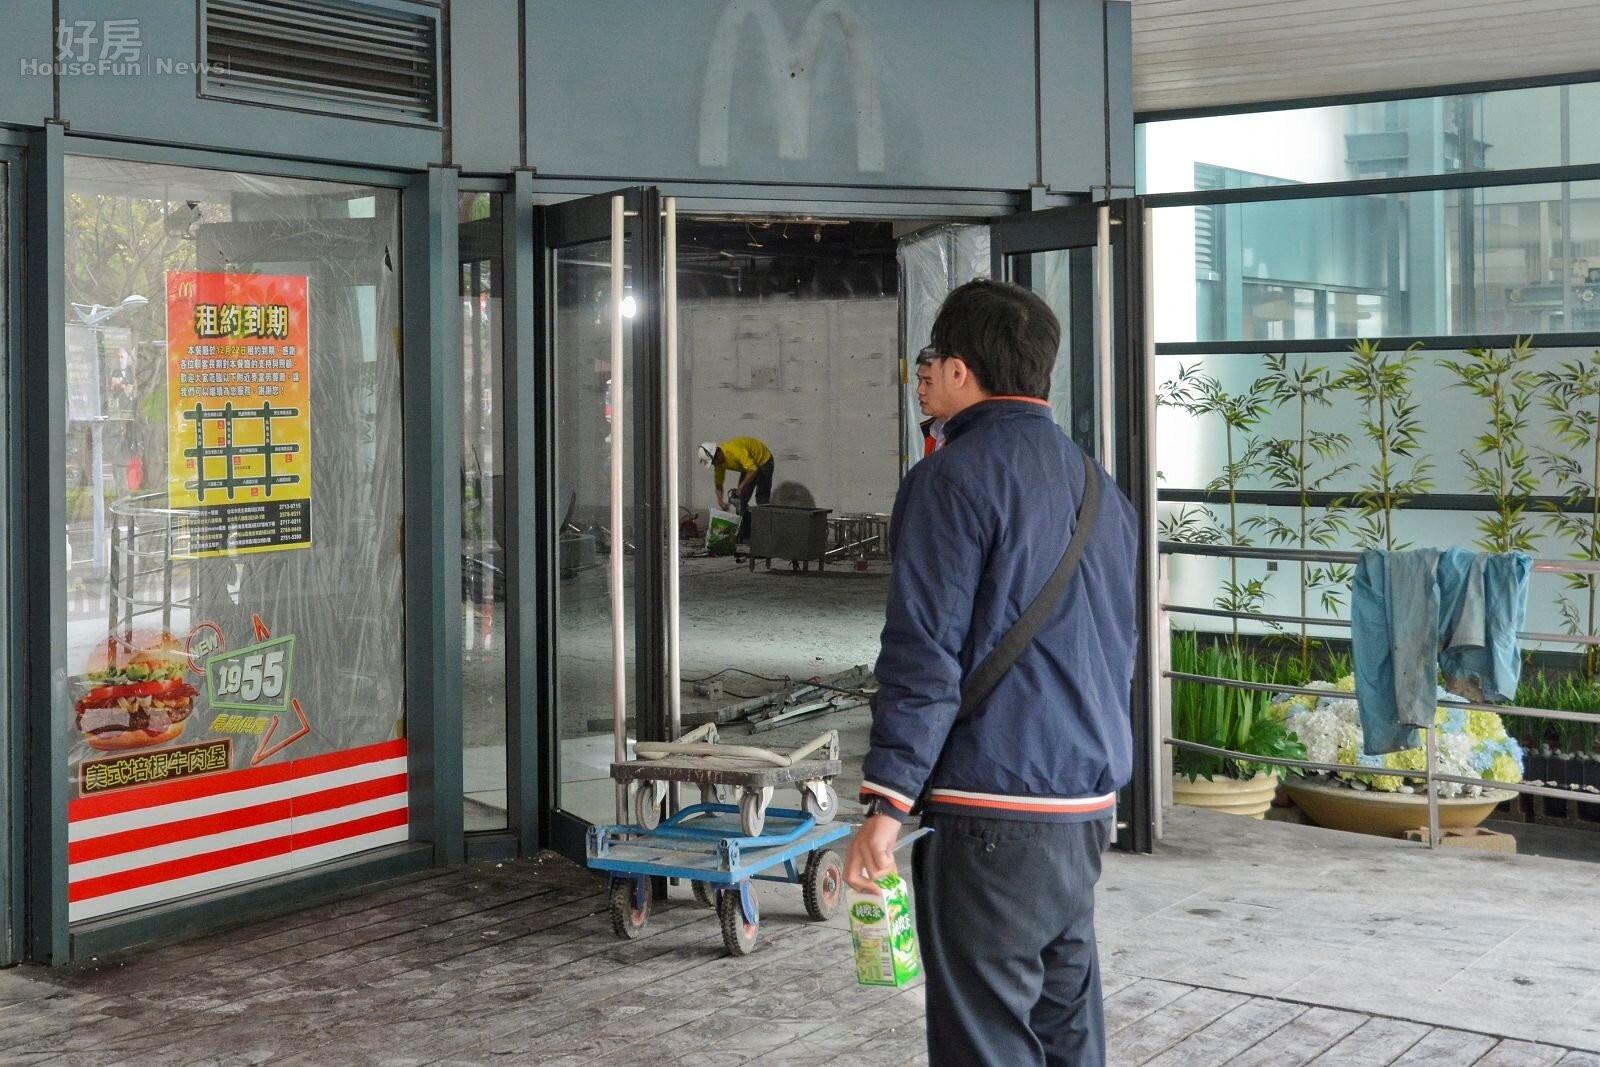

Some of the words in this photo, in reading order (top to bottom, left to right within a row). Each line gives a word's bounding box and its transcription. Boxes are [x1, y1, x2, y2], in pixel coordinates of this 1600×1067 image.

[195, 304, 289, 339] 租約到期
[190, 634, 219, 660] NEW
[217, 651, 285, 702] 1955
[85, 744, 226, 791] 美式培根牛肉堡
